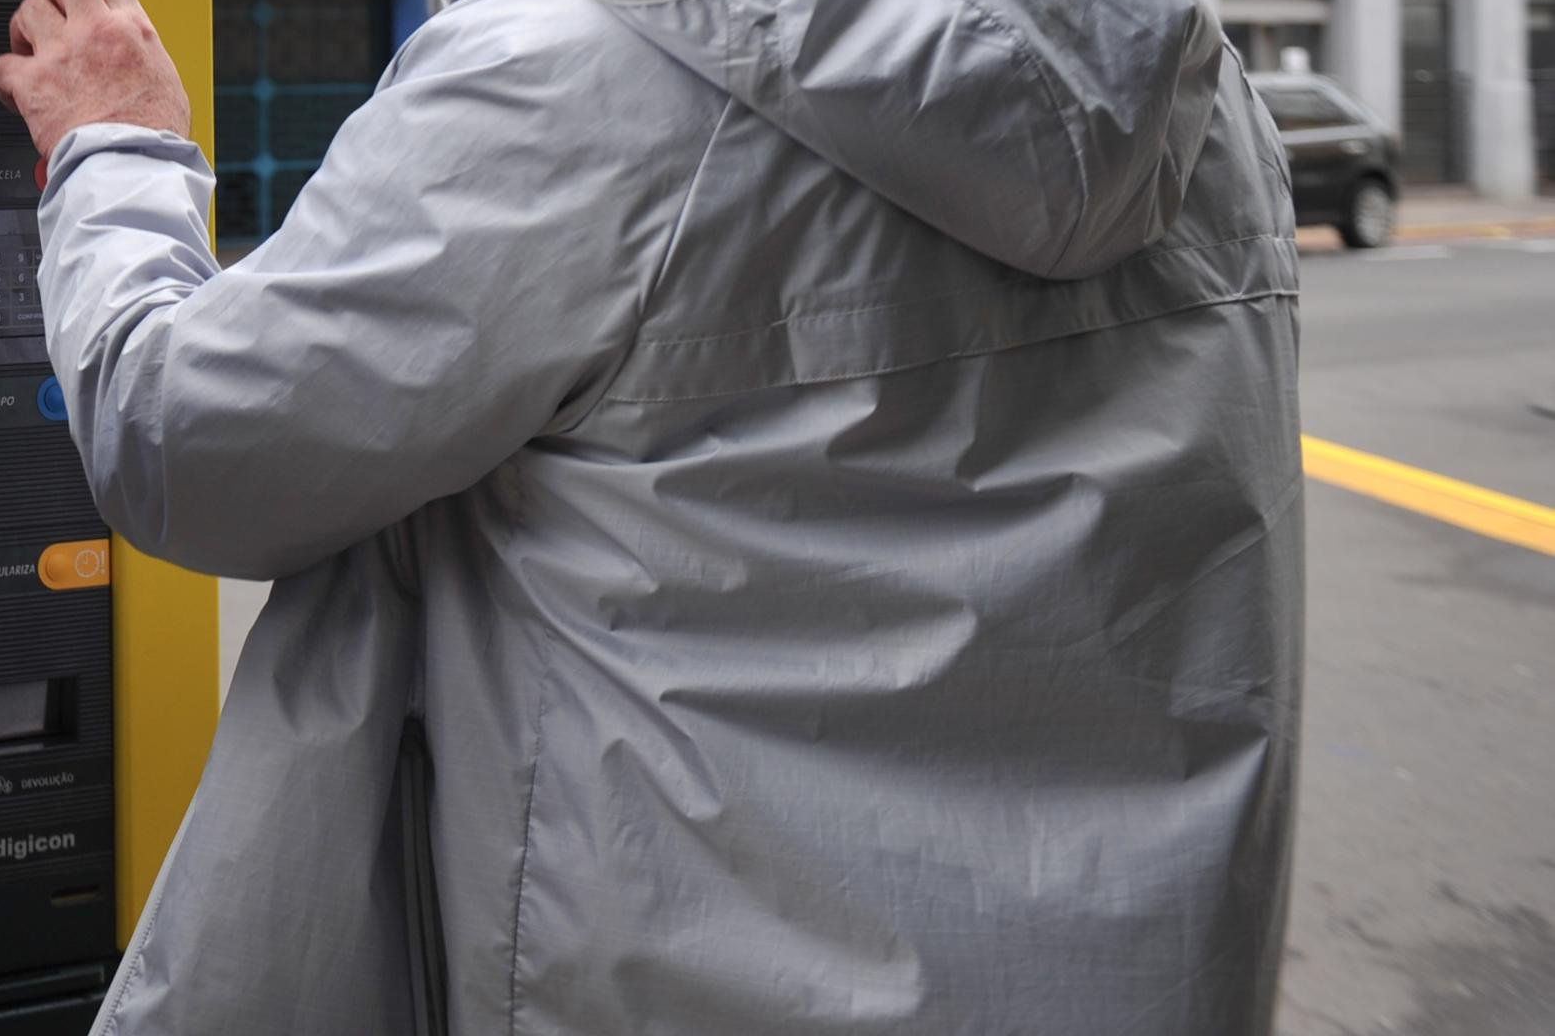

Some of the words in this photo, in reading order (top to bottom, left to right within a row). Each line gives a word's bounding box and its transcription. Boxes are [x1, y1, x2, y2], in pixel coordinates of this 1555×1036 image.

[18, 274, 25, 283] 6
[18, 293, 25, 303] 3
[20, 772, 75, 789] DEVOLUÇÃO
